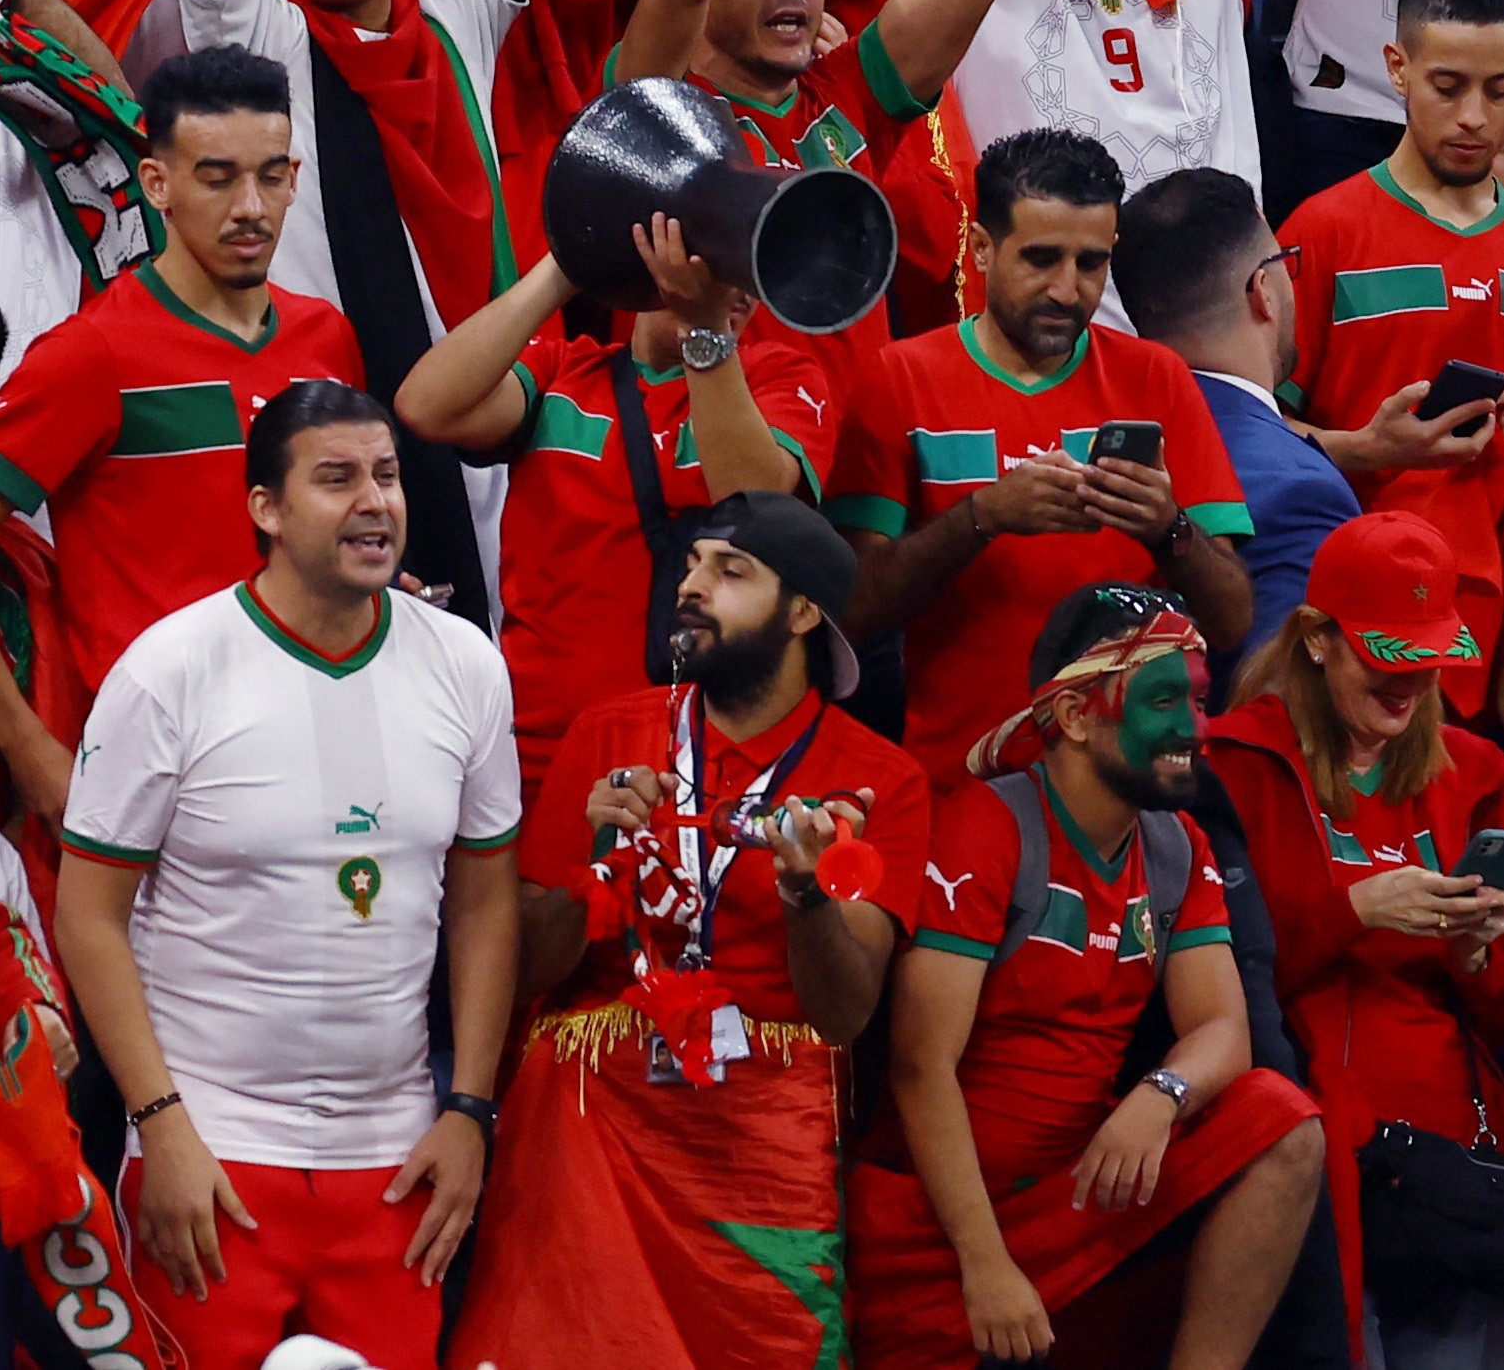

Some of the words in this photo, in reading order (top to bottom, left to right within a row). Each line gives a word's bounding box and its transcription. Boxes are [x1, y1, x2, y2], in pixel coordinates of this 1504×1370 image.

[1102, 27, 1144, 93] 9
[1452, 285, 1487, 301] PUMA
[335, 821, 371, 835] PUMA
